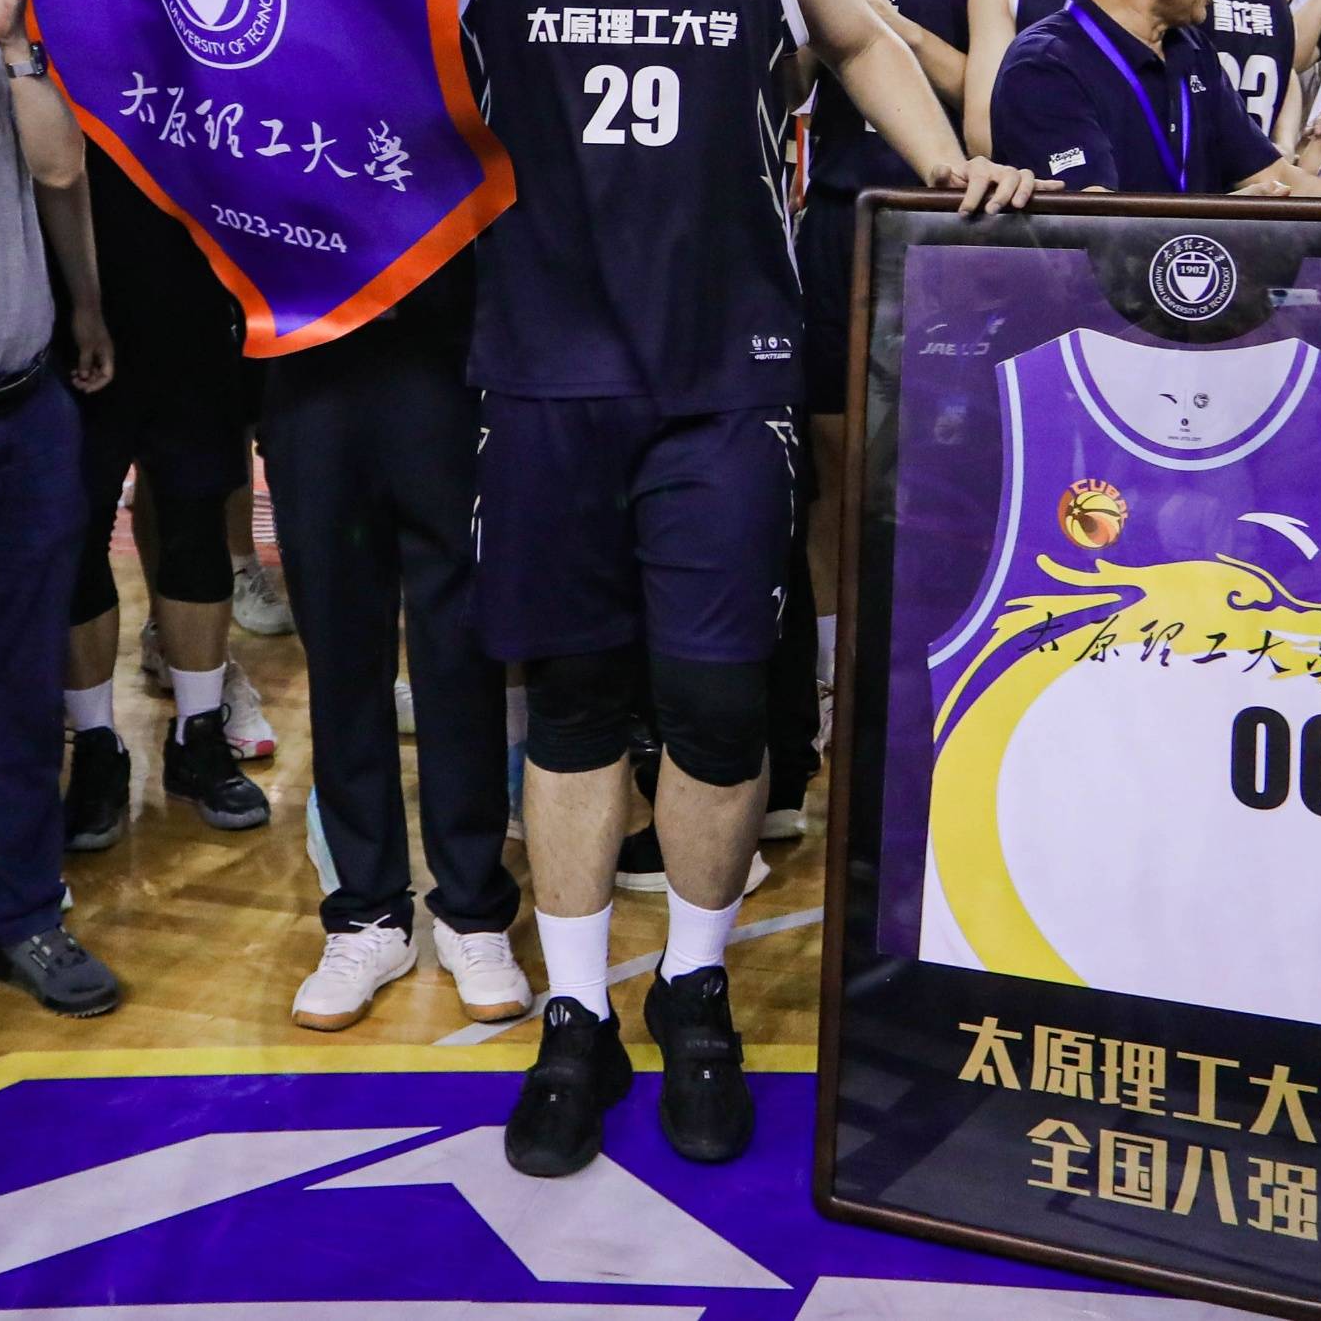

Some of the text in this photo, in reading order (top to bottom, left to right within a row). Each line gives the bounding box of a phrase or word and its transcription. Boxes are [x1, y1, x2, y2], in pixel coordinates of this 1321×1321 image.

[168, 0, 227, 56] UNIVERSITY
[229, 37, 247, 55] OF
[527, 7, 739, 47] 太原理工大学
[582, 64, 680, 147] 29
[211, 203, 348, 254] 2023-2024
[1180, 265, 1206, 275] 1902
[1026, 1118, 1320, 1243] 全国八强
